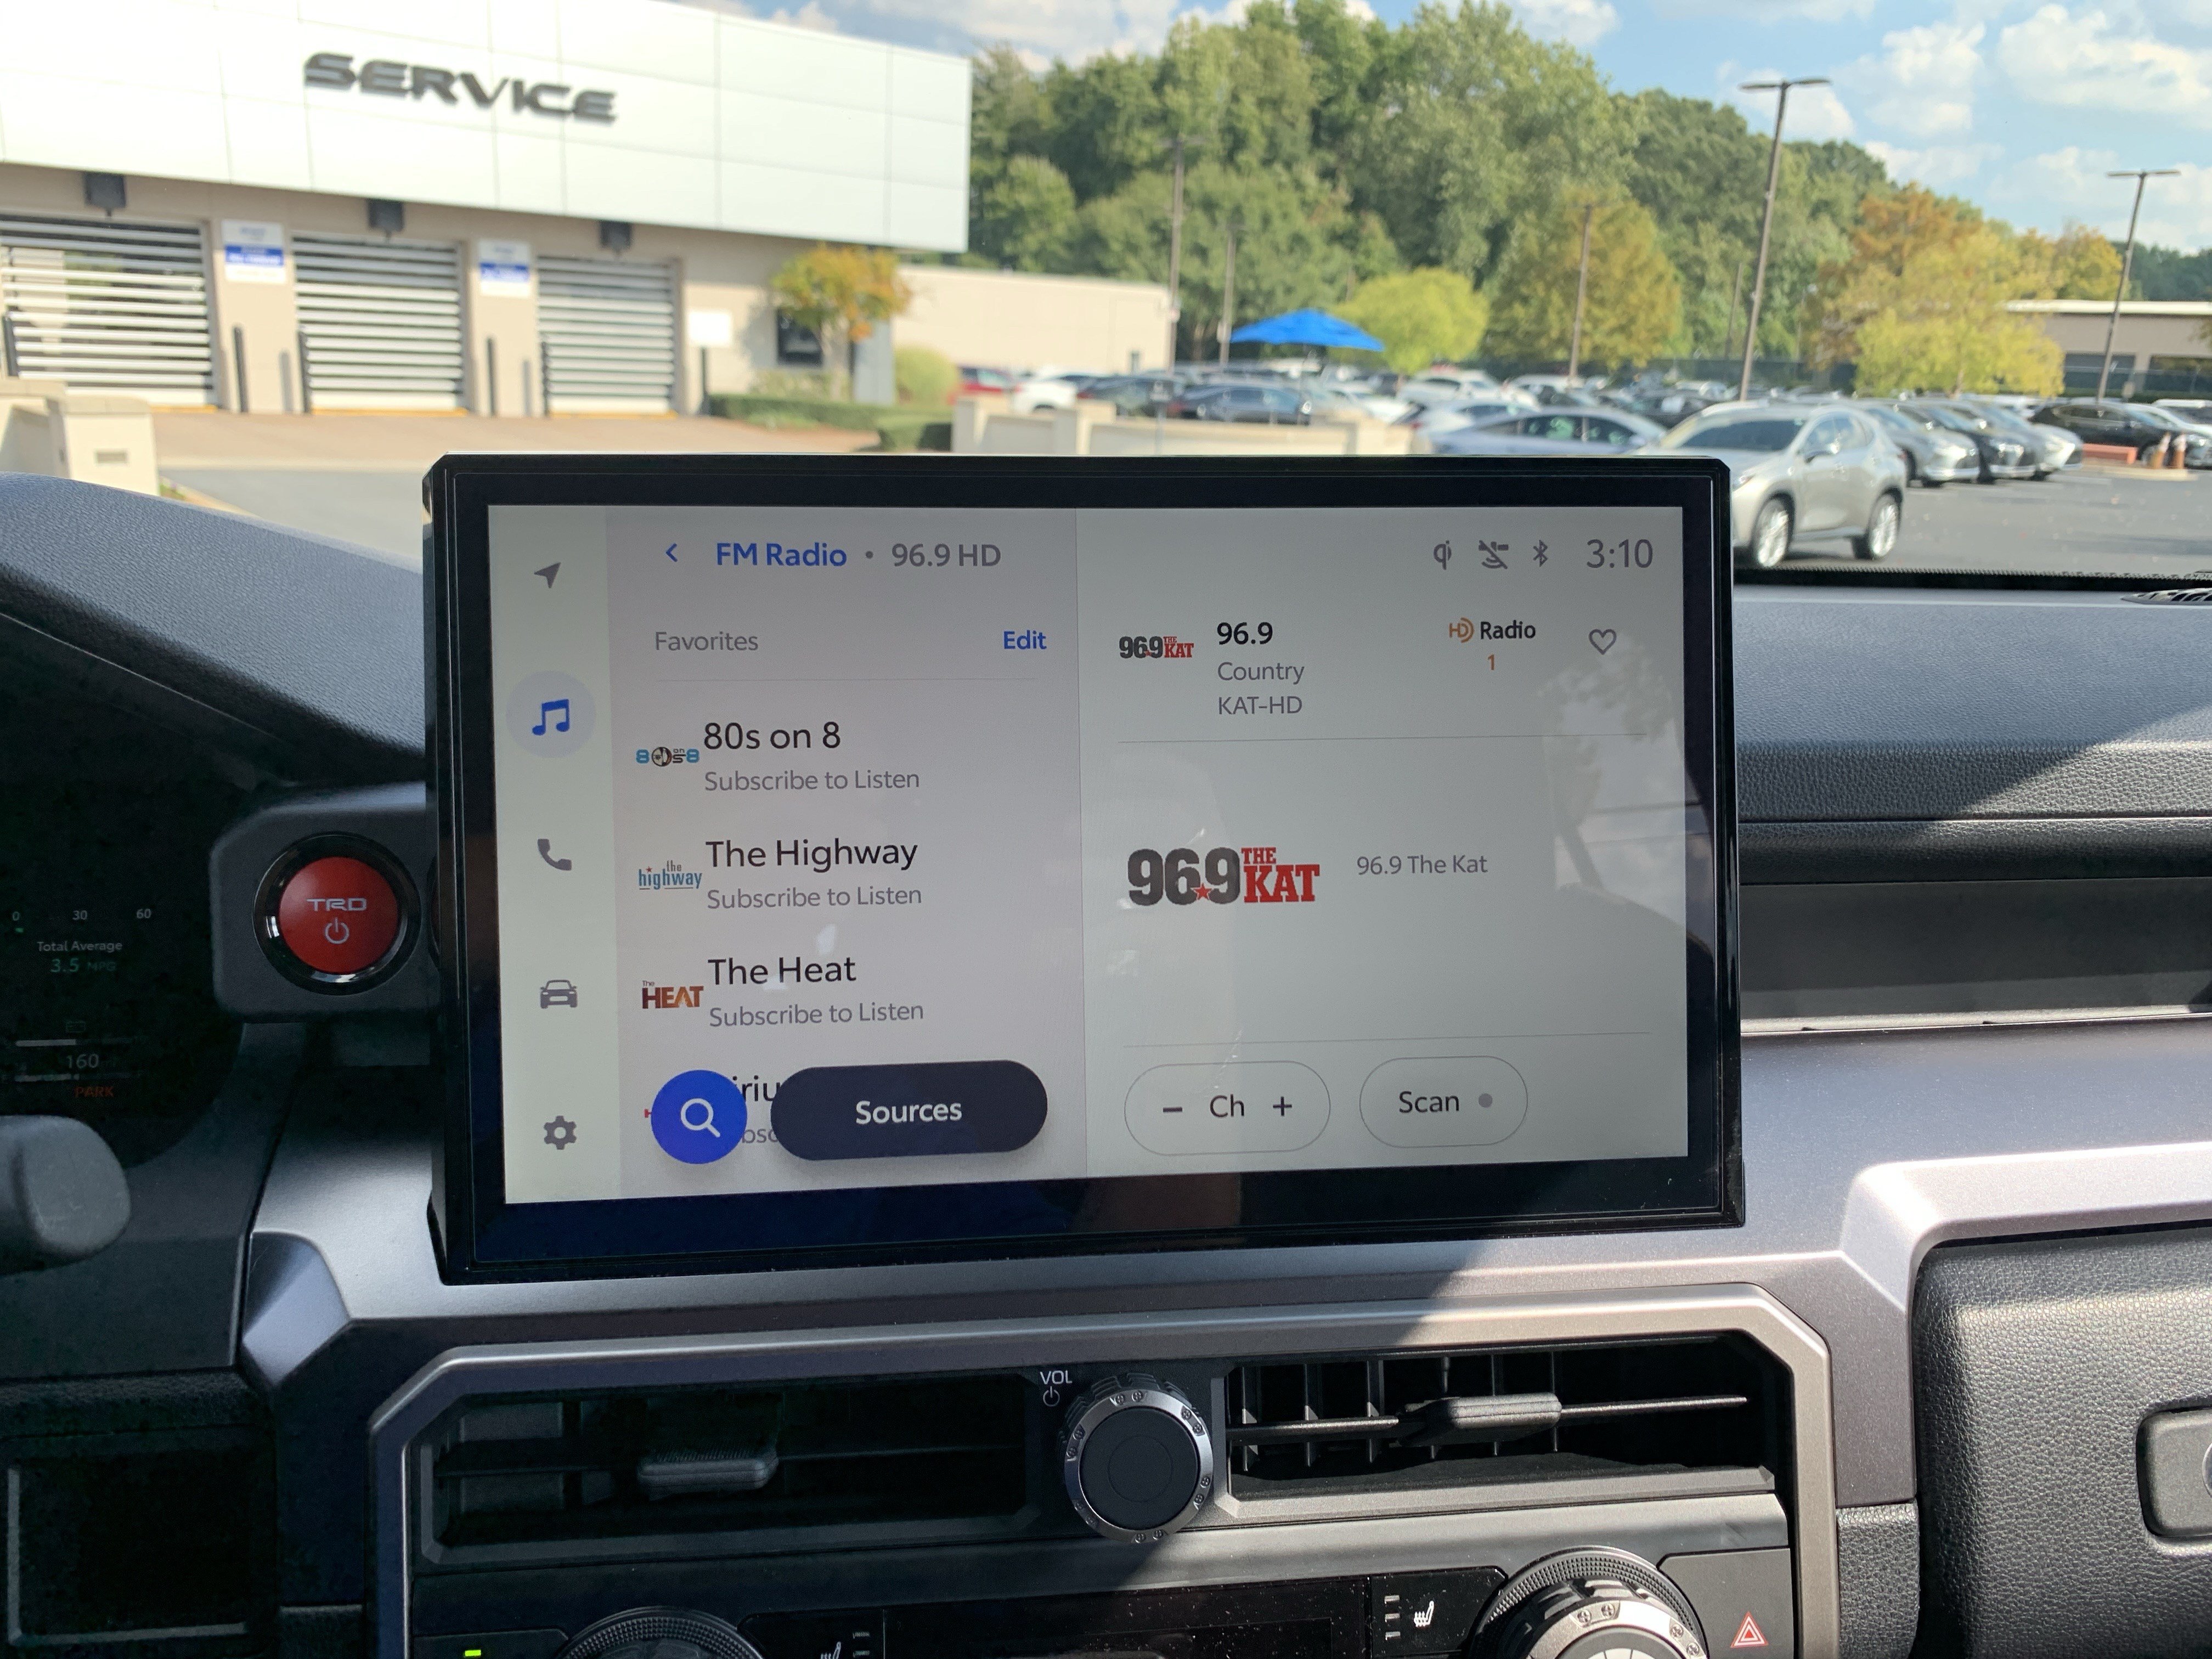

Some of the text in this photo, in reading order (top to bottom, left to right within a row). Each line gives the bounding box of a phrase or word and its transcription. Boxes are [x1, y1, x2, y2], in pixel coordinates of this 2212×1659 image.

[304, 53, 616, 124] SERVICE
[717, 542, 1001, 567] FM Radio 96.9 HD
[1587, 539, 1653, 568] 3:10
[1004, 630, 1047, 650] Edit
[1217, 622, 1273, 645] 96.9
[1481, 620, 1536, 640] Radio
[656, 631, 758, 651] Favorites
[1164, 642, 1194, 658] KAT
[1488, 654, 1494, 670] 1
[1218, 662, 1304, 685] Country
[1219, 696, 1302, 714] KAT-HD
[704, 721, 840, 749] 80s on 8
[705, 770, 919, 791] Subscribe to Listen
[706, 838, 917, 873] The Highway
[1242, 847, 1277, 865] THE
[1357, 855, 1488, 875] 96.9 The Kat
[665, 861, 682, 871] the
[638, 869, 702, 890] highway
[1243, 864, 1321, 904] KAT
[306, 898, 368, 912] TRD
[708, 886, 921, 909] Subscribe to Listen
[72, 910, 88, 921] 30
[136, 908, 151, 919] 60
[37, 941, 123, 953] Total Average
[50, 958, 80, 973] 3.5
[708, 957, 856, 985] The Heat
[642, 986, 704, 1009] HEAT
[710, 1002, 923, 1027] Subscribe to Listen
[66, 1053, 99, 1069] 160
[74, 1085, 114, 1098] PARK
[1210, 1094, 1244, 1118] Ch
[1400, 1091, 1459, 1113] Scan
[856, 1101, 962, 1124] Sources
[1040, 1370, 1072, 1384] VOL
